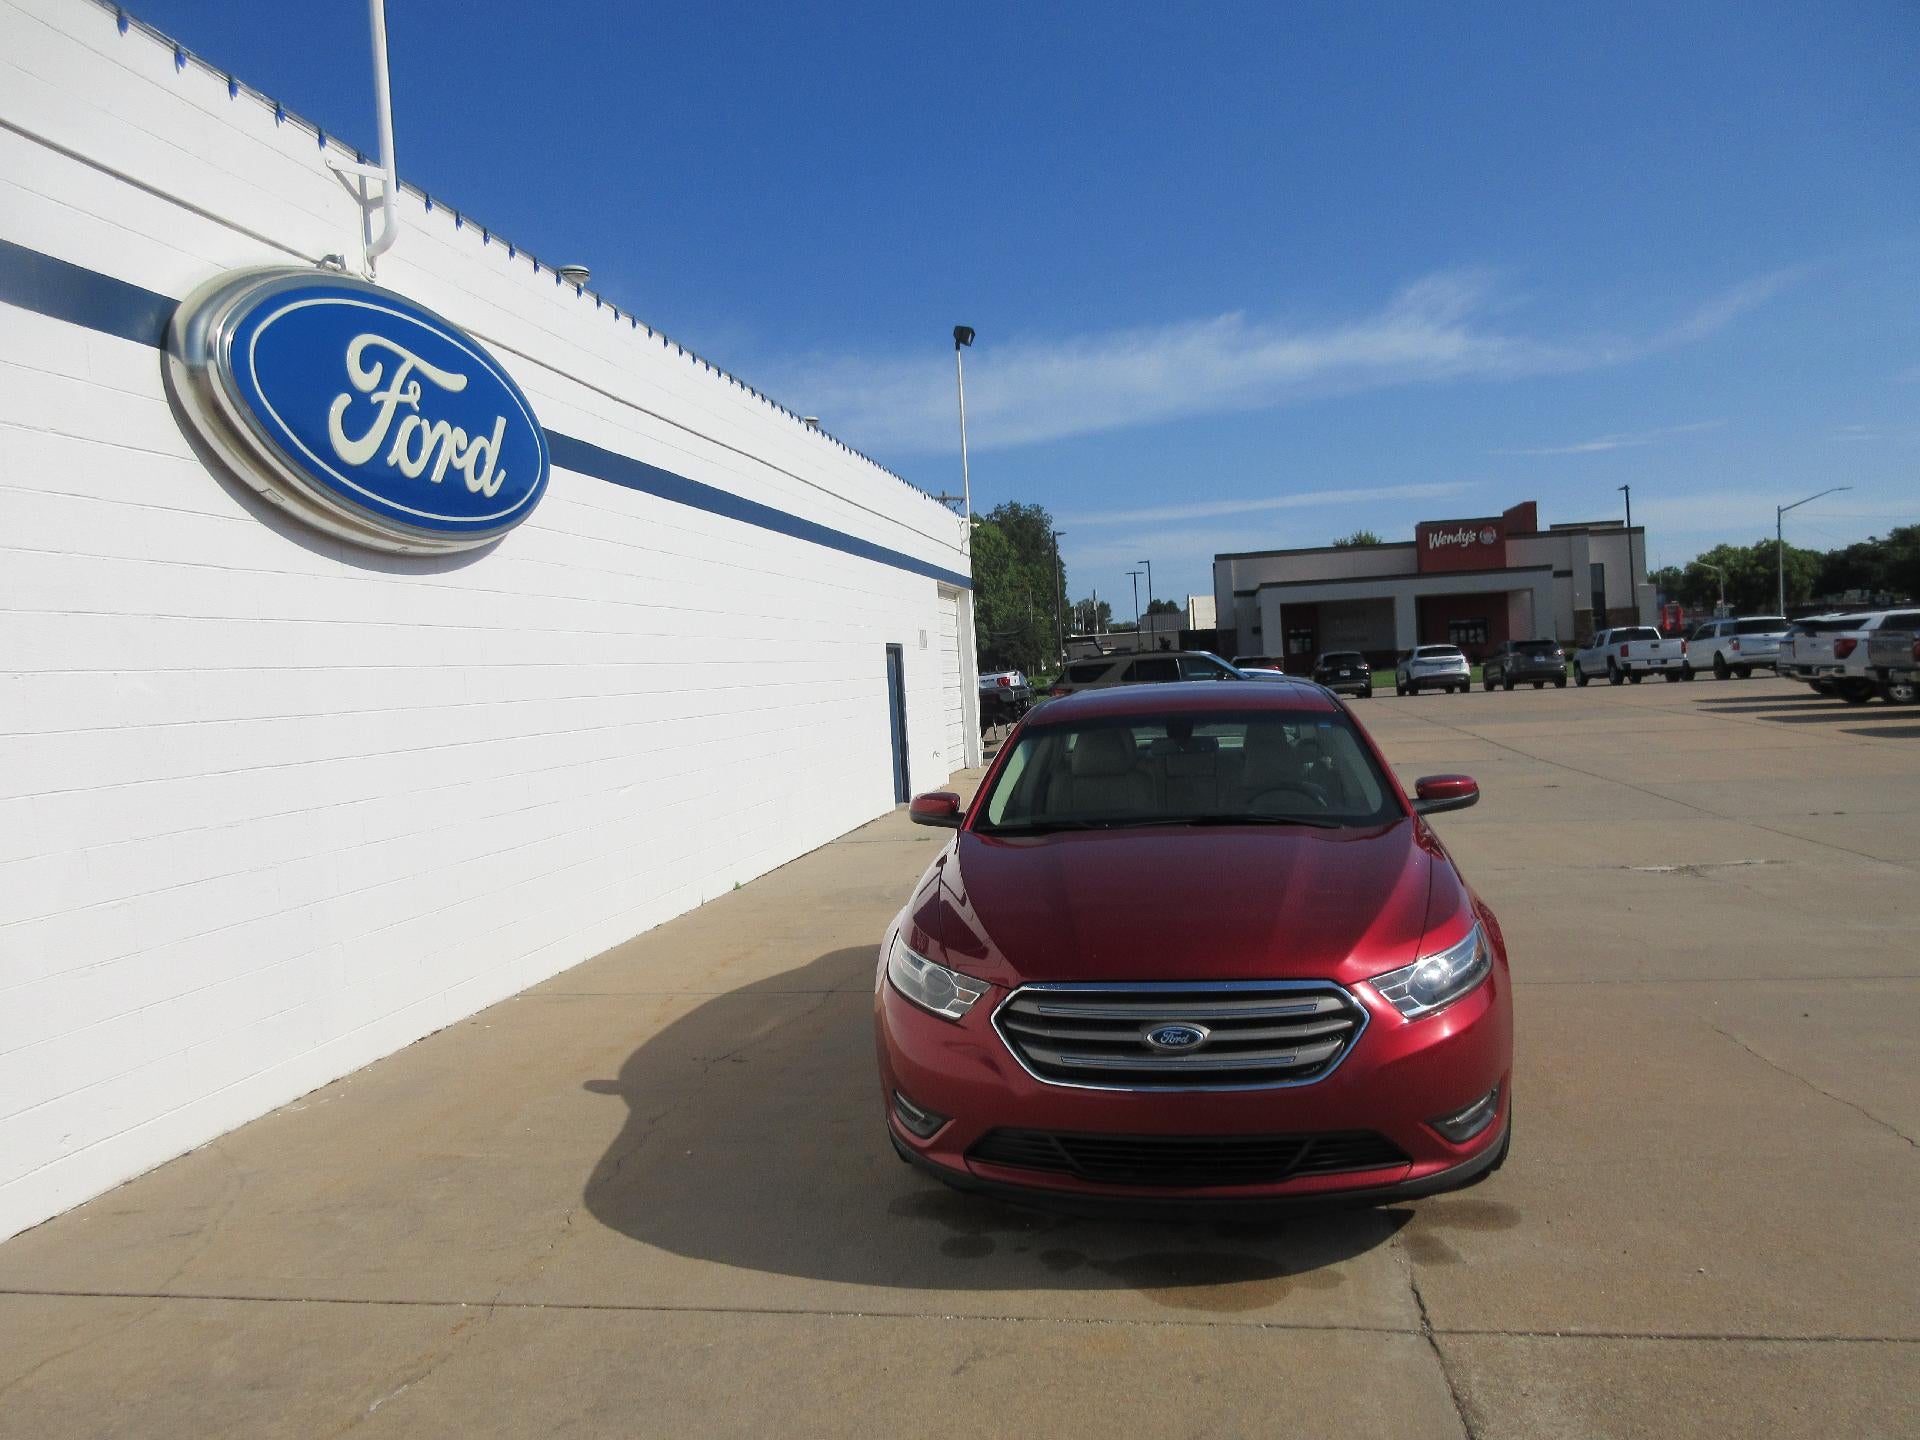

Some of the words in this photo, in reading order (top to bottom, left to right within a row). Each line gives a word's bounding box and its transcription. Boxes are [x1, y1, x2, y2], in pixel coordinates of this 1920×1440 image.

[329, 333, 506, 497] Ford
[1428, 528, 1477, 550] Wendy's
[1160, 1030, 1190, 1044] Ford
